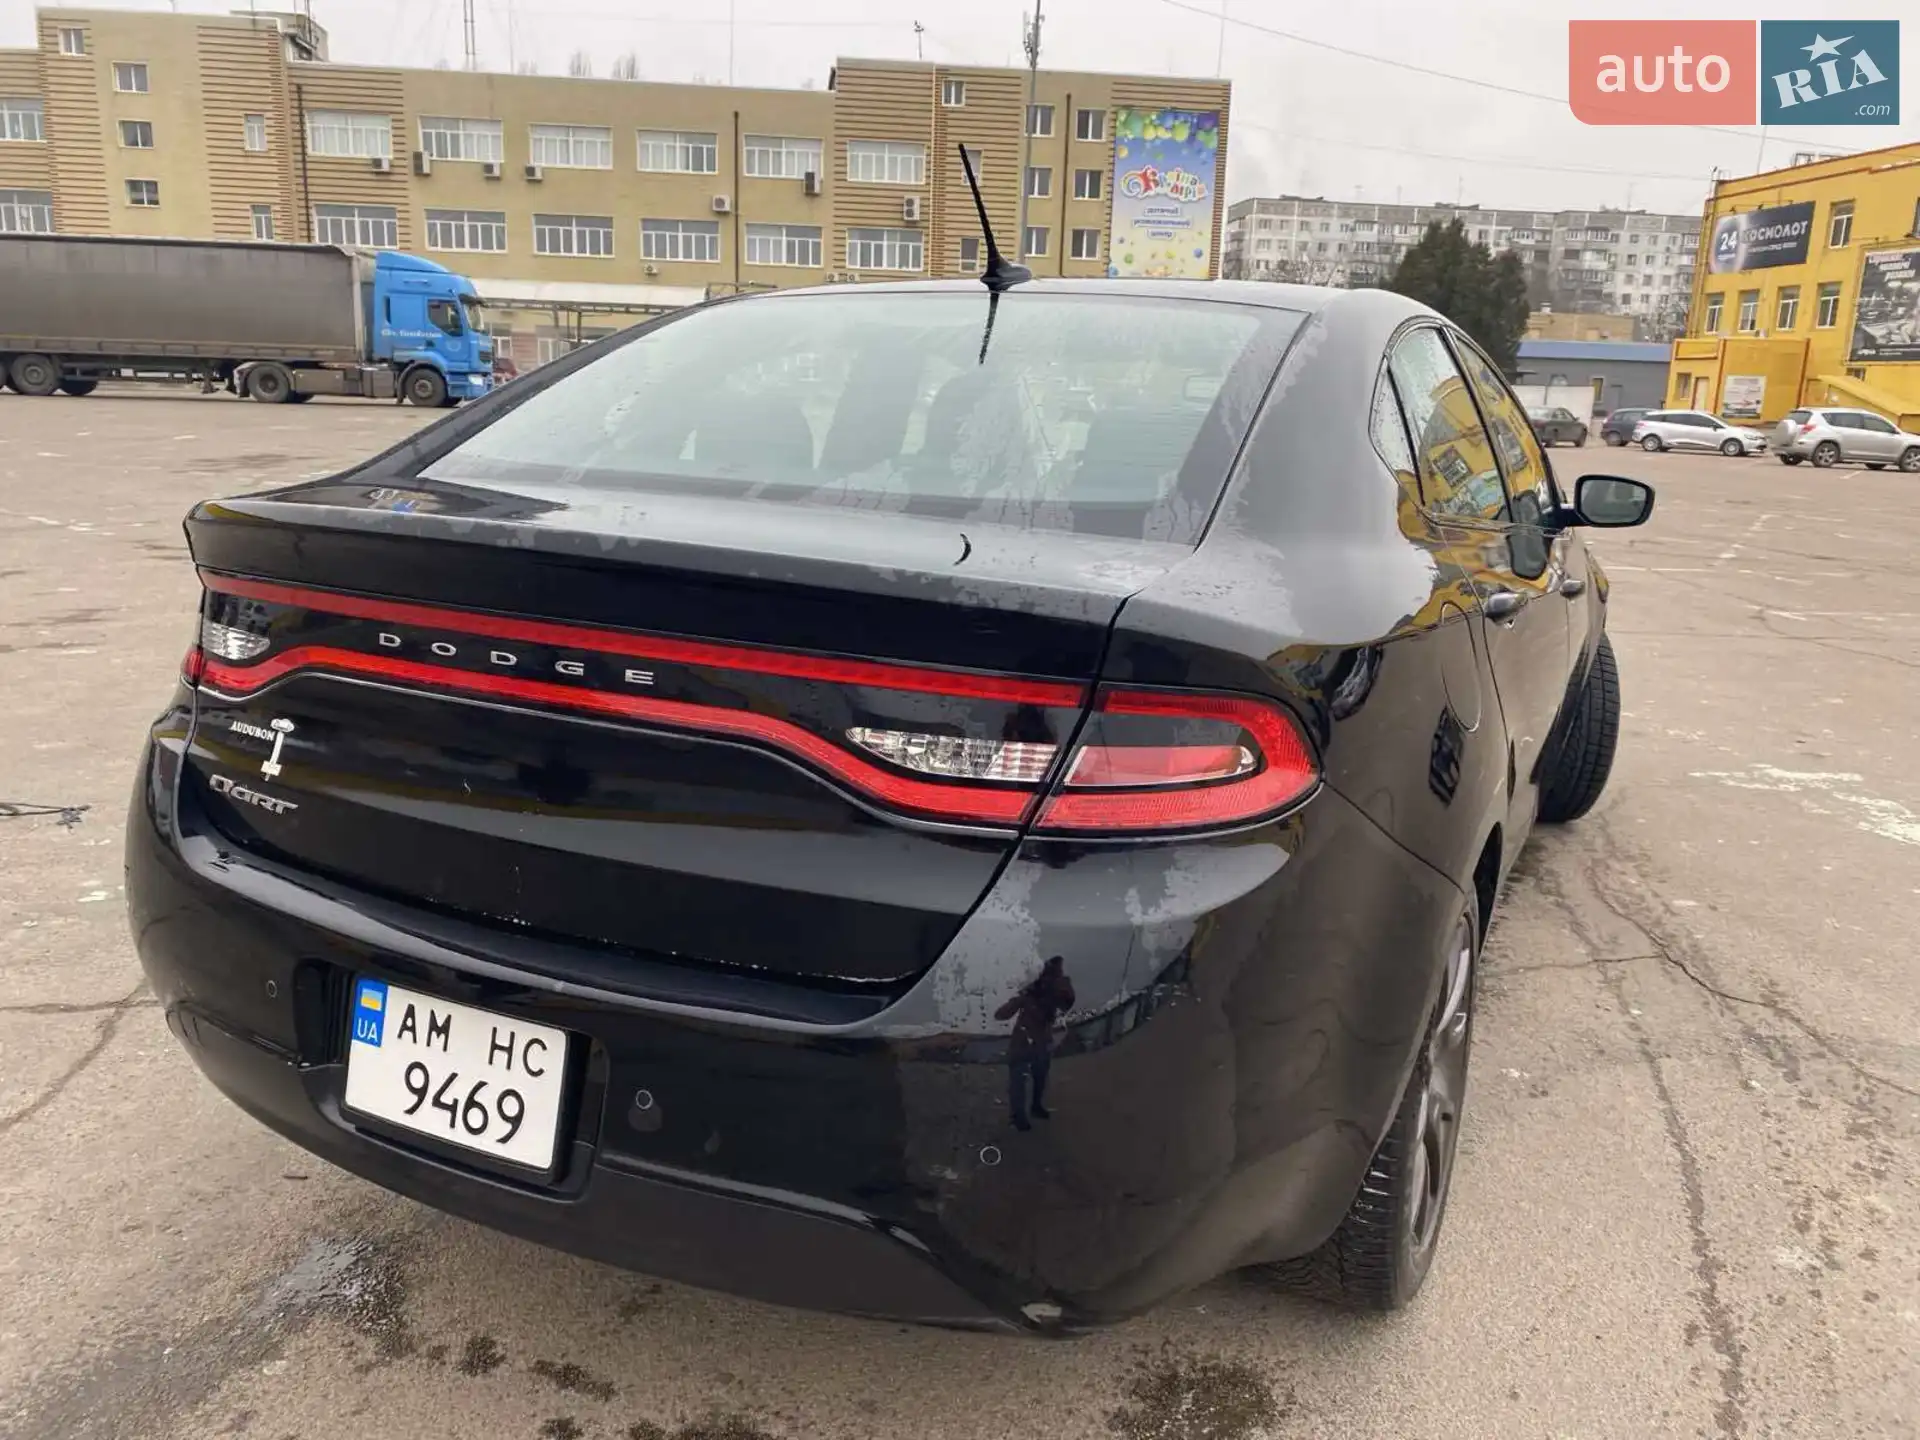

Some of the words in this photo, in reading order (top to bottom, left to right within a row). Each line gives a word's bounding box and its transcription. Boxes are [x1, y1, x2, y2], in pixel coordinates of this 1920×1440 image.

[1720, 231, 1737, 251] 24
[1743, 221, 1808, 242] КОСМОЛОТ
[379, 632, 654, 685] DODGE
[228, 720, 276, 741] AUDUBON
[356, 1018, 378, 1042] UA
[397, 1003, 452, 1052] AM
[488, 1026, 548, 1077] HC
[403, 1061, 525, 1144] 9469
